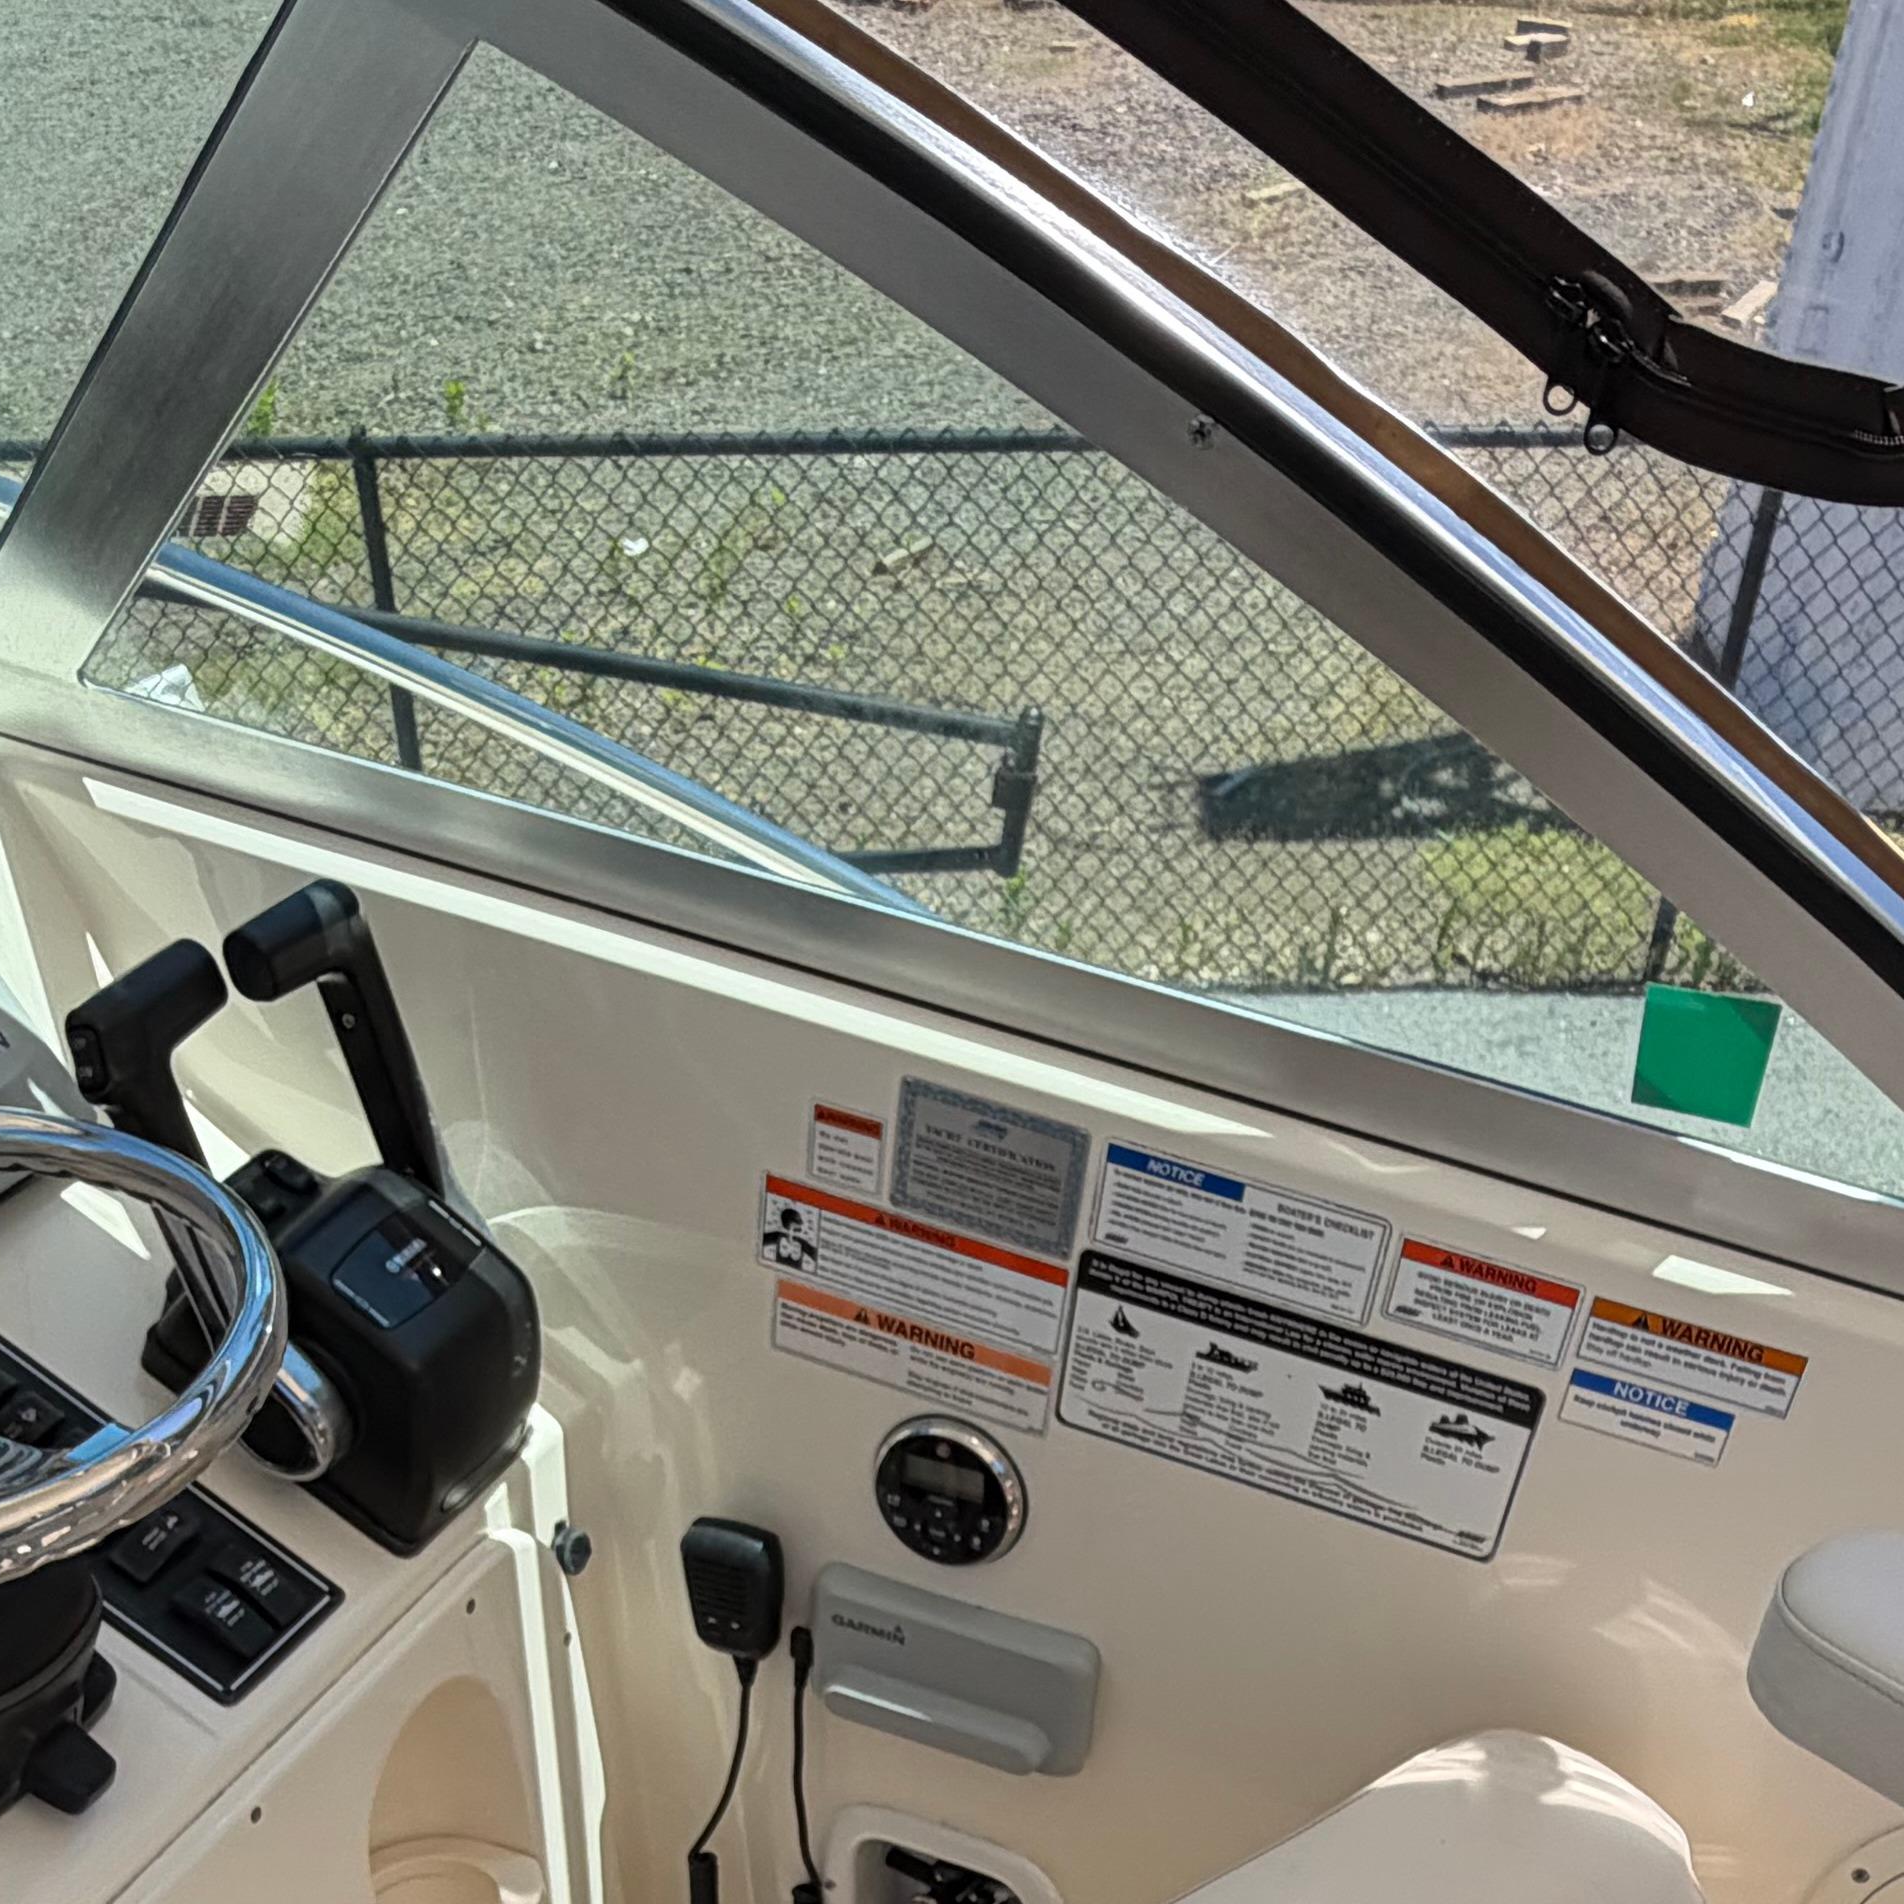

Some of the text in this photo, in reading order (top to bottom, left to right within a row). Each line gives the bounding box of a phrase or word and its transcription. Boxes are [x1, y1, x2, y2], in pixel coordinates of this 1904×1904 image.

[1147, 1157, 1205, 1188] NOTICE
[1458, 1259, 1537, 1292] WARNING
[877, 1314, 974, 1360] WARNING
[1659, 1318, 1766, 1363] WARNING
[1612, 1382, 1690, 1417] NOTICE
[830, 1612, 906, 1647] GARMIN
